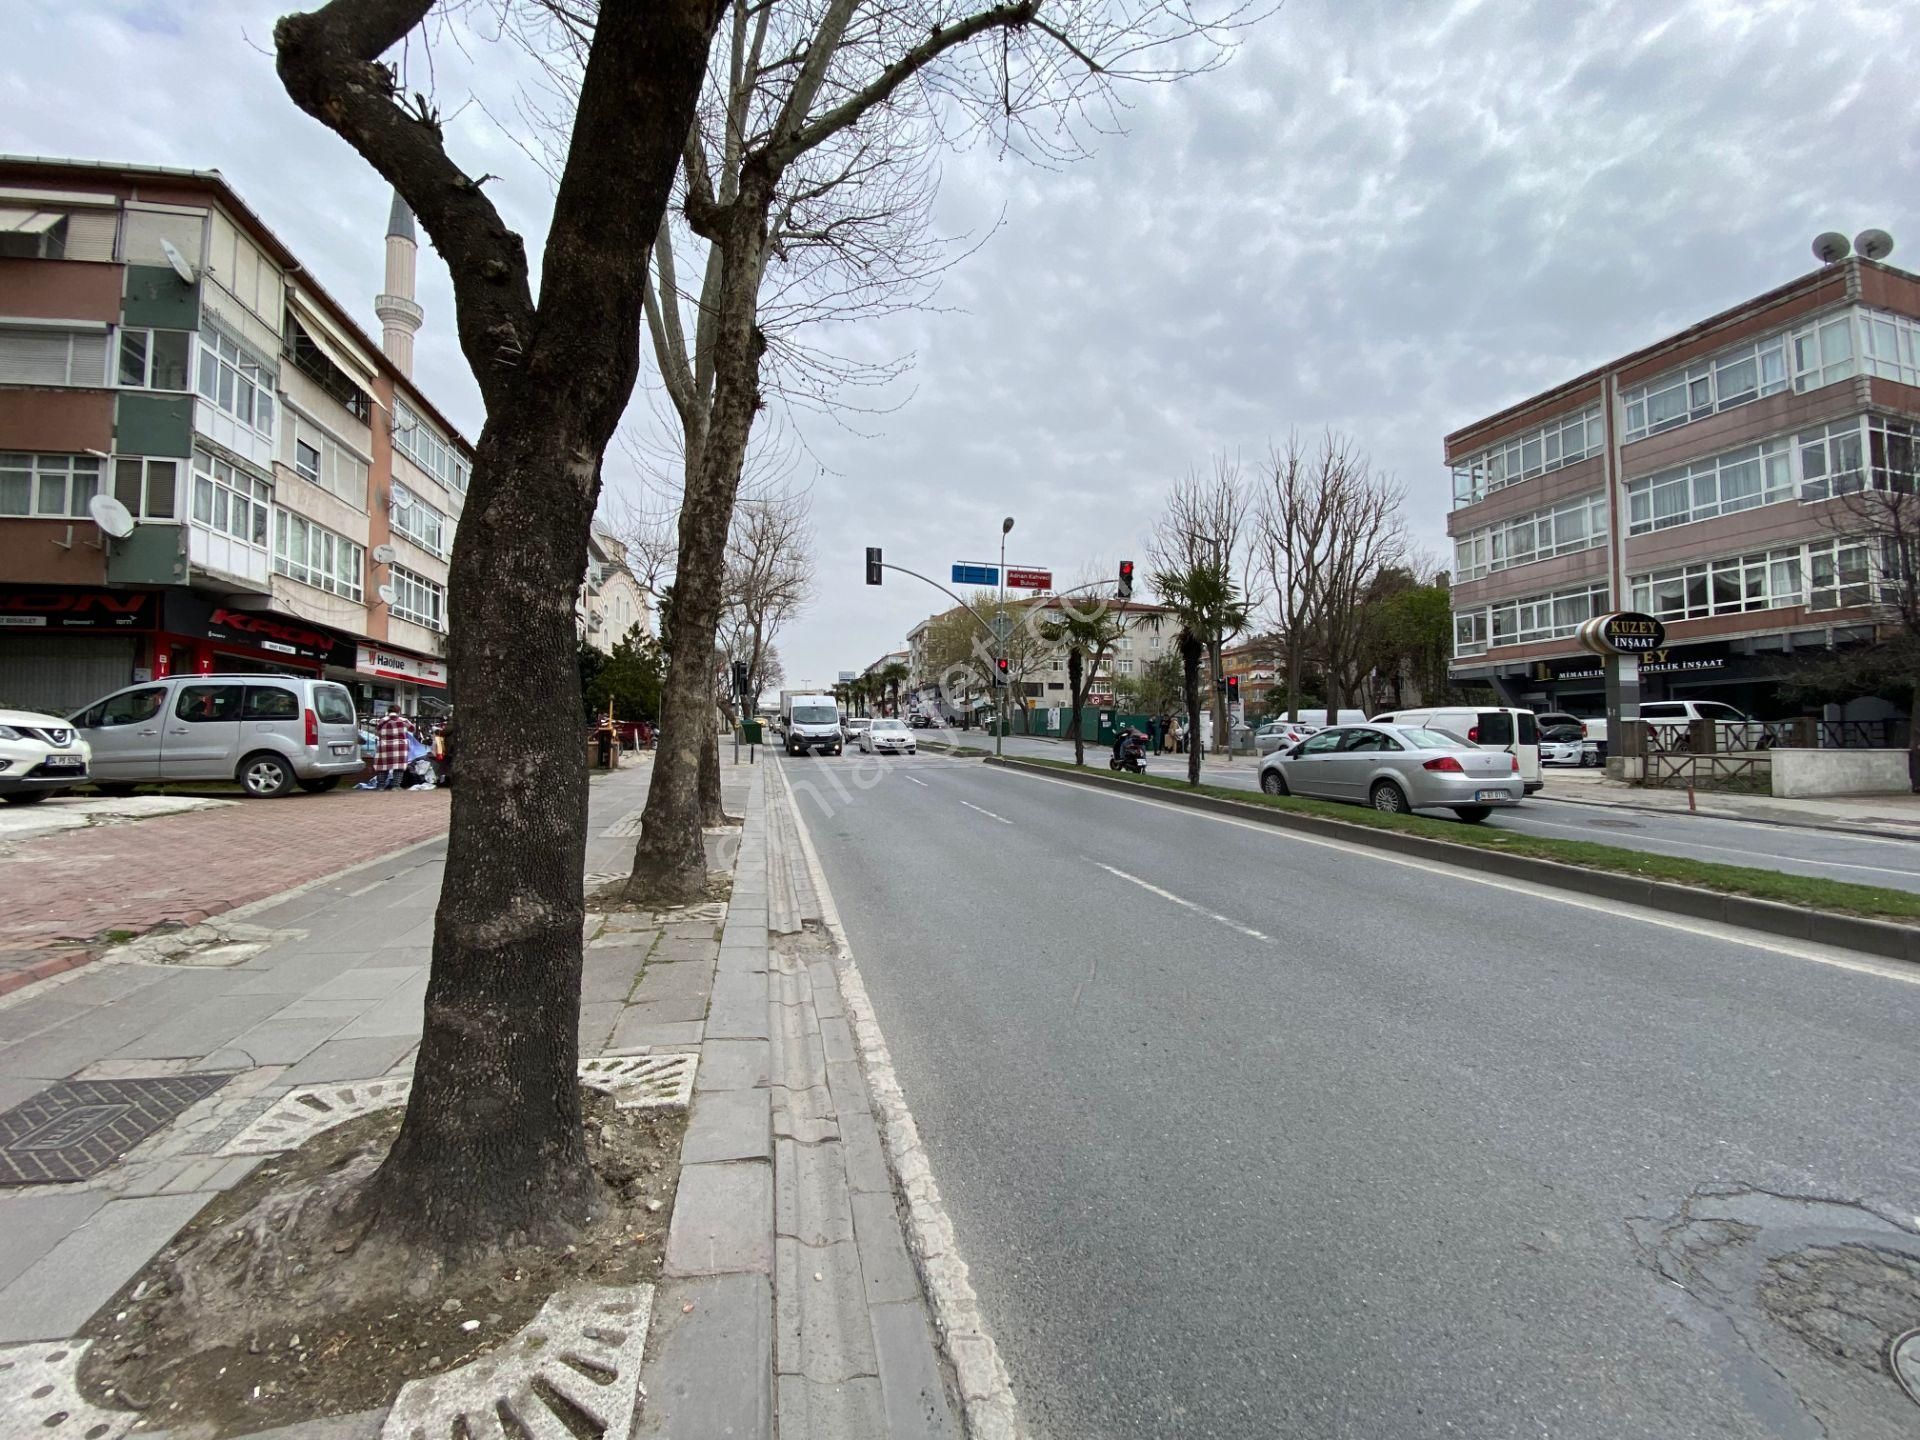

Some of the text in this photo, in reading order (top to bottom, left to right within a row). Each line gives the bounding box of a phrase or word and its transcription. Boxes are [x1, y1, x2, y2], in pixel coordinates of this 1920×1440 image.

[1611, 620, 1657, 634] KUZEY
[1614, 635, 1655, 650] İNŞAAT
[377, 654, 405, 671] Haojue
[1558, 669, 1605, 679] MİMARLIK
[1682, 659, 1724, 670] İNŞAAT
